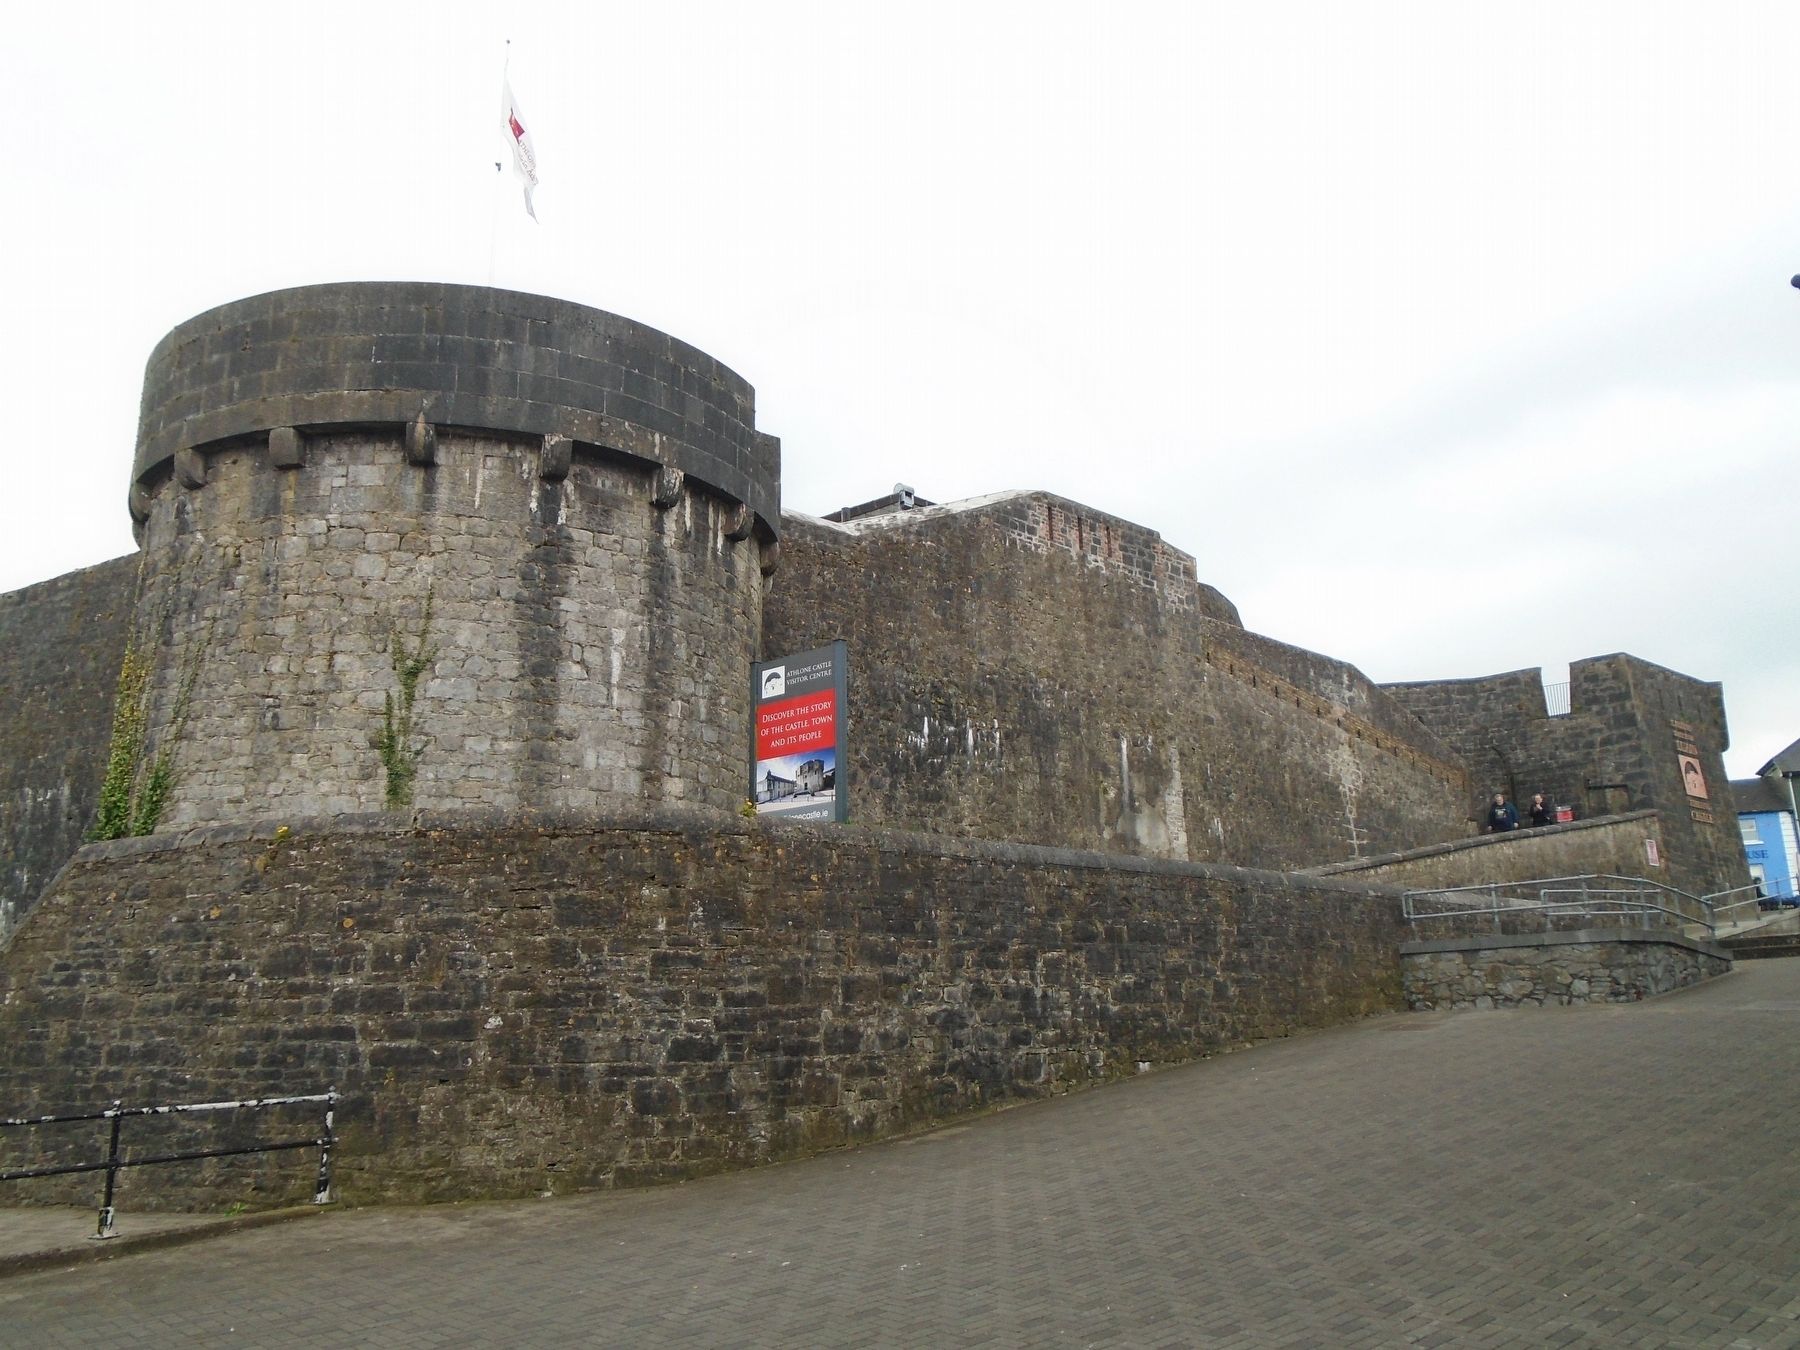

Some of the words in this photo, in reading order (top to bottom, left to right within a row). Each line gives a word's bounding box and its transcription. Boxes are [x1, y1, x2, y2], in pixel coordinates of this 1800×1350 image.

[786, 666, 811, 677] ATHLONE
[812, 660, 832, 671] CASTLE
[786, 675, 809, 685] VISITOR
[810, 669, 832, 680] CENTRE
[762, 709, 795, 723] DISCOVER
[796, 705, 809, 715] THE
[811, 701, 832, 712] STORY
[761, 728, 770, 736] OF
[771, 725, 783, 734] THE
[812, 714, 833, 725] TOWN
[770, 738, 785, 748] AND
[787, 735, 797, 745] ITS
[798, 730, 822, 742] PEOPLE
